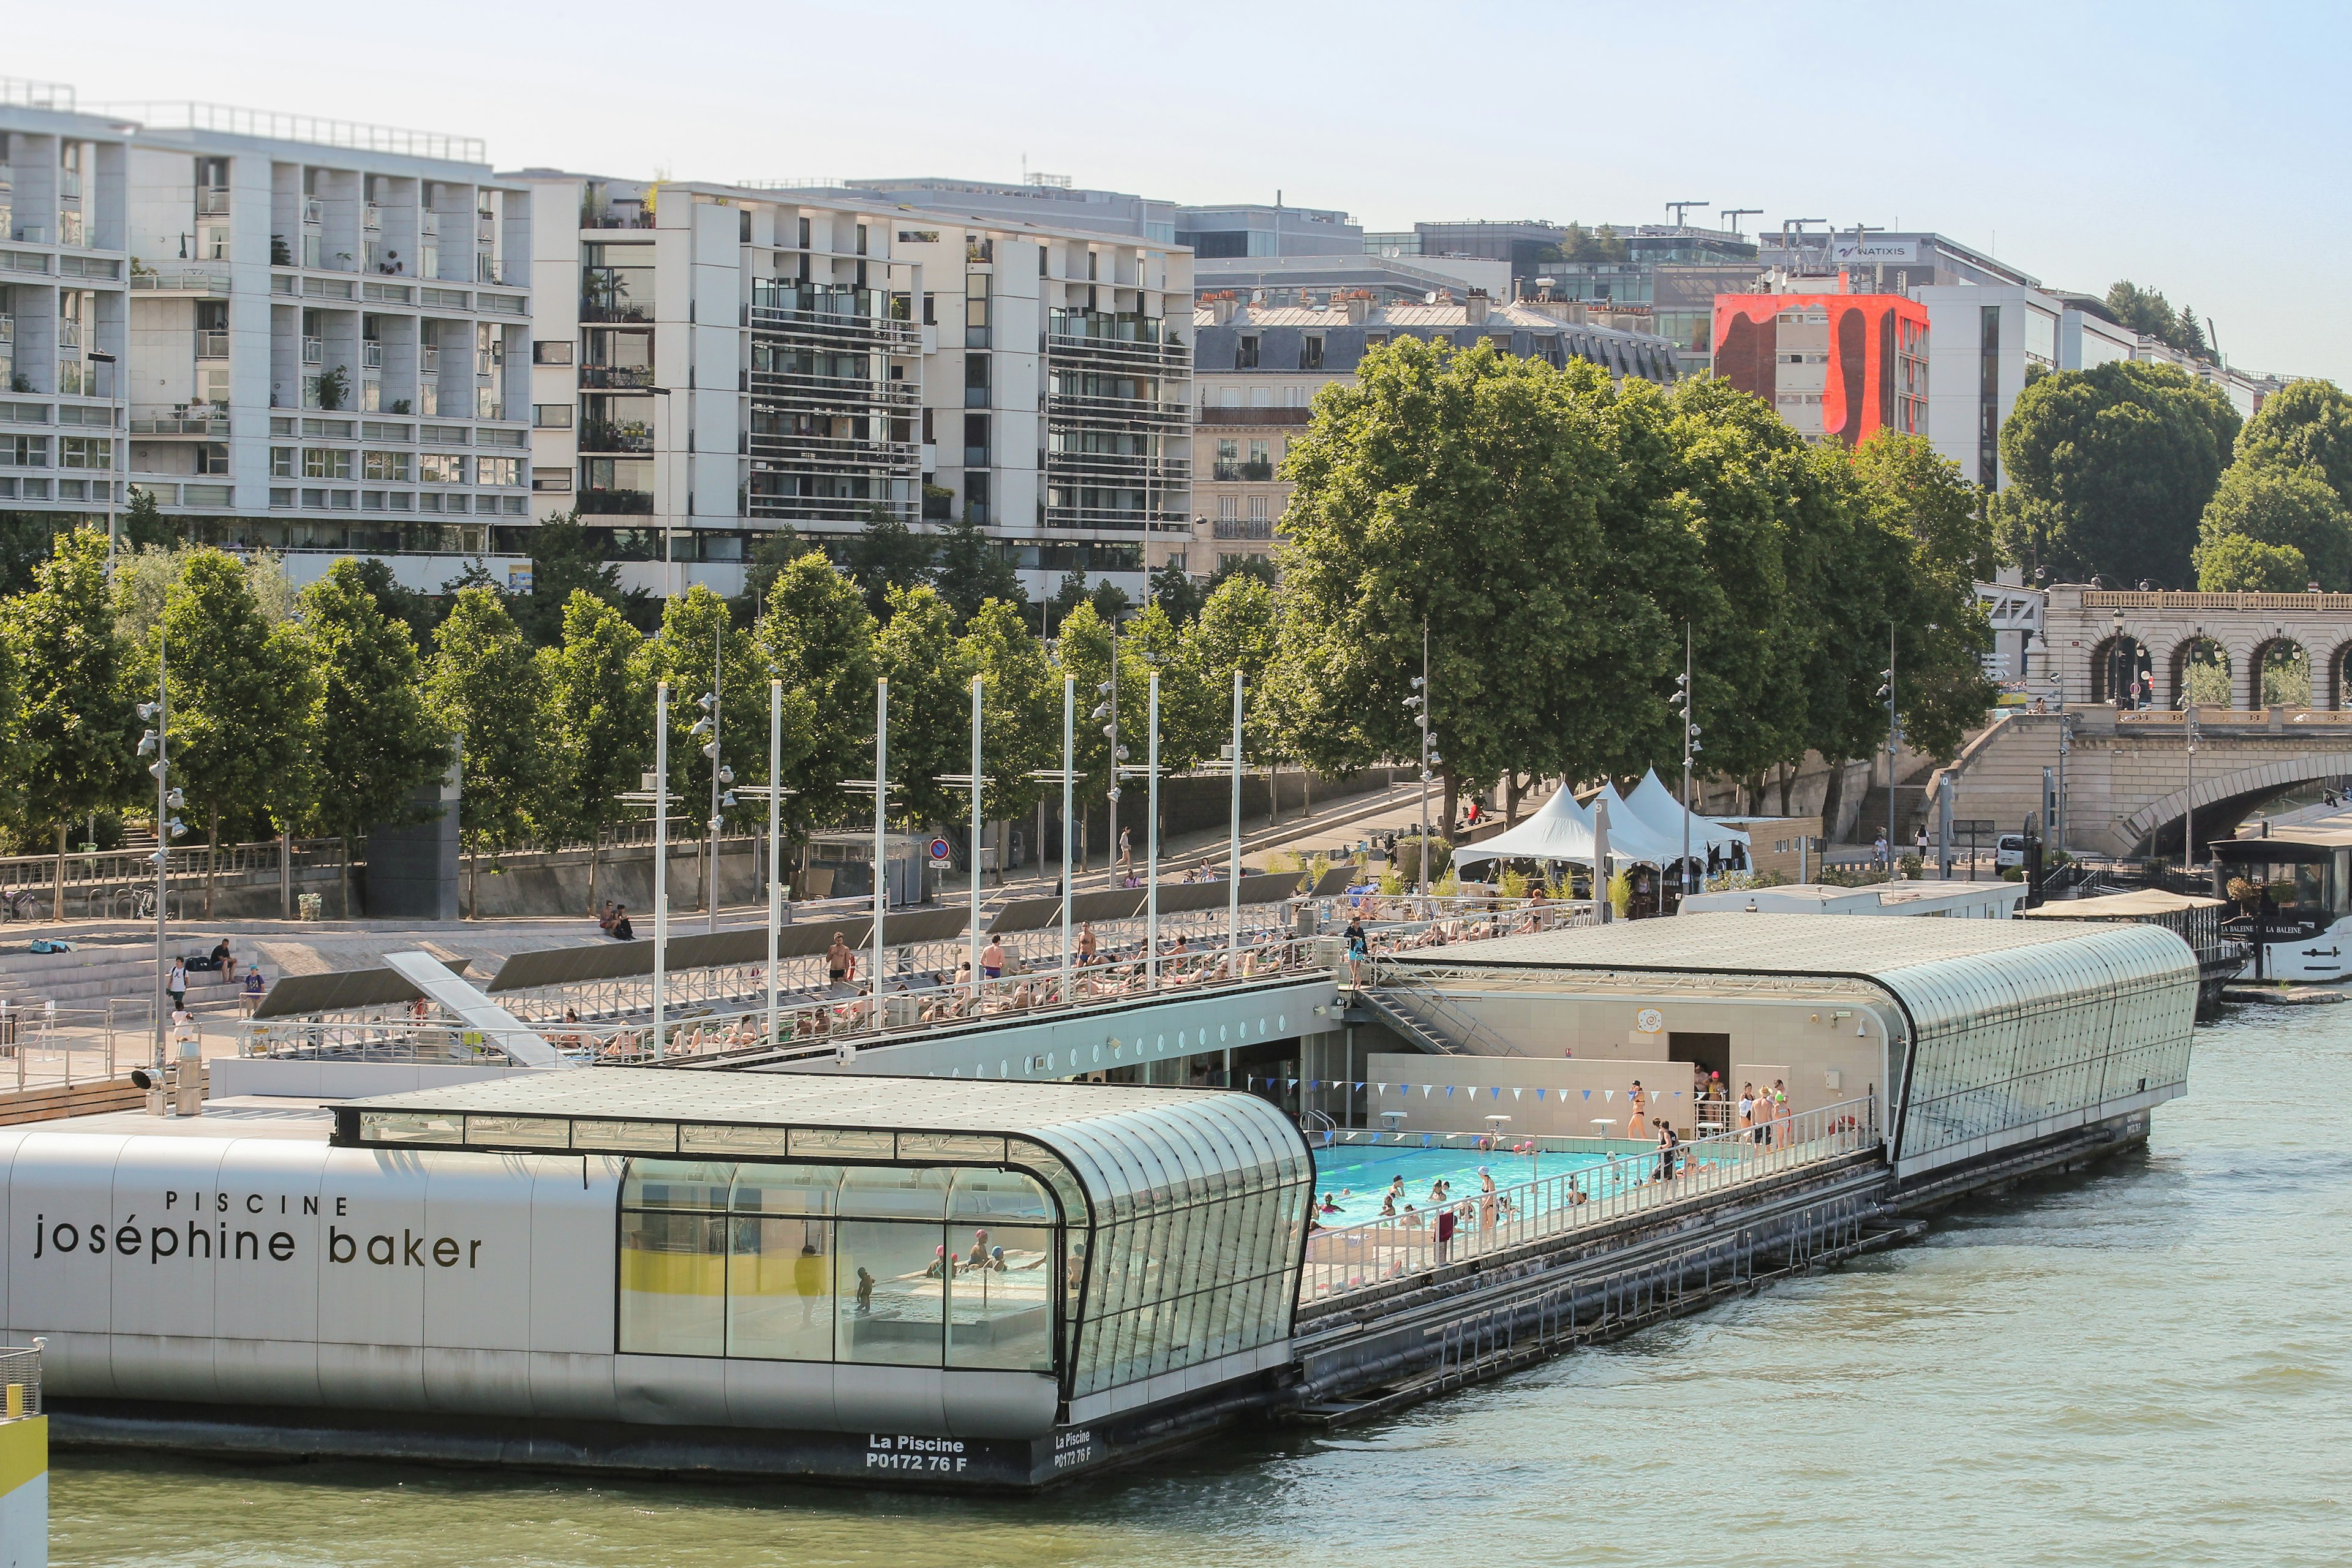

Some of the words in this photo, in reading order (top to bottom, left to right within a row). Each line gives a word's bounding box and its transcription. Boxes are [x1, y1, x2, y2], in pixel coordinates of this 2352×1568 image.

[1596, 802, 1603, 813] 9
[166, 1190, 347, 1216] PISCINE
[34, 1213, 295, 1264] joséphine
[329, 1225, 481, 1269] baker
[870, 1434, 891, 1449] La
[897, 1435, 964, 1453] Piscine
[1055, 1436, 1065, 1450] La
[1066, 1430, 1090, 1447] Piscine
[866, 1453, 922, 1470] P0172
[928, 1456, 951, 1472] 76
[956, 1458, 967, 1472] F
[1055, 1451, 1076, 1468] P0172
[1077, 1448, 1085, 1463] 76
[1086, 1446, 1091, 1461] F
